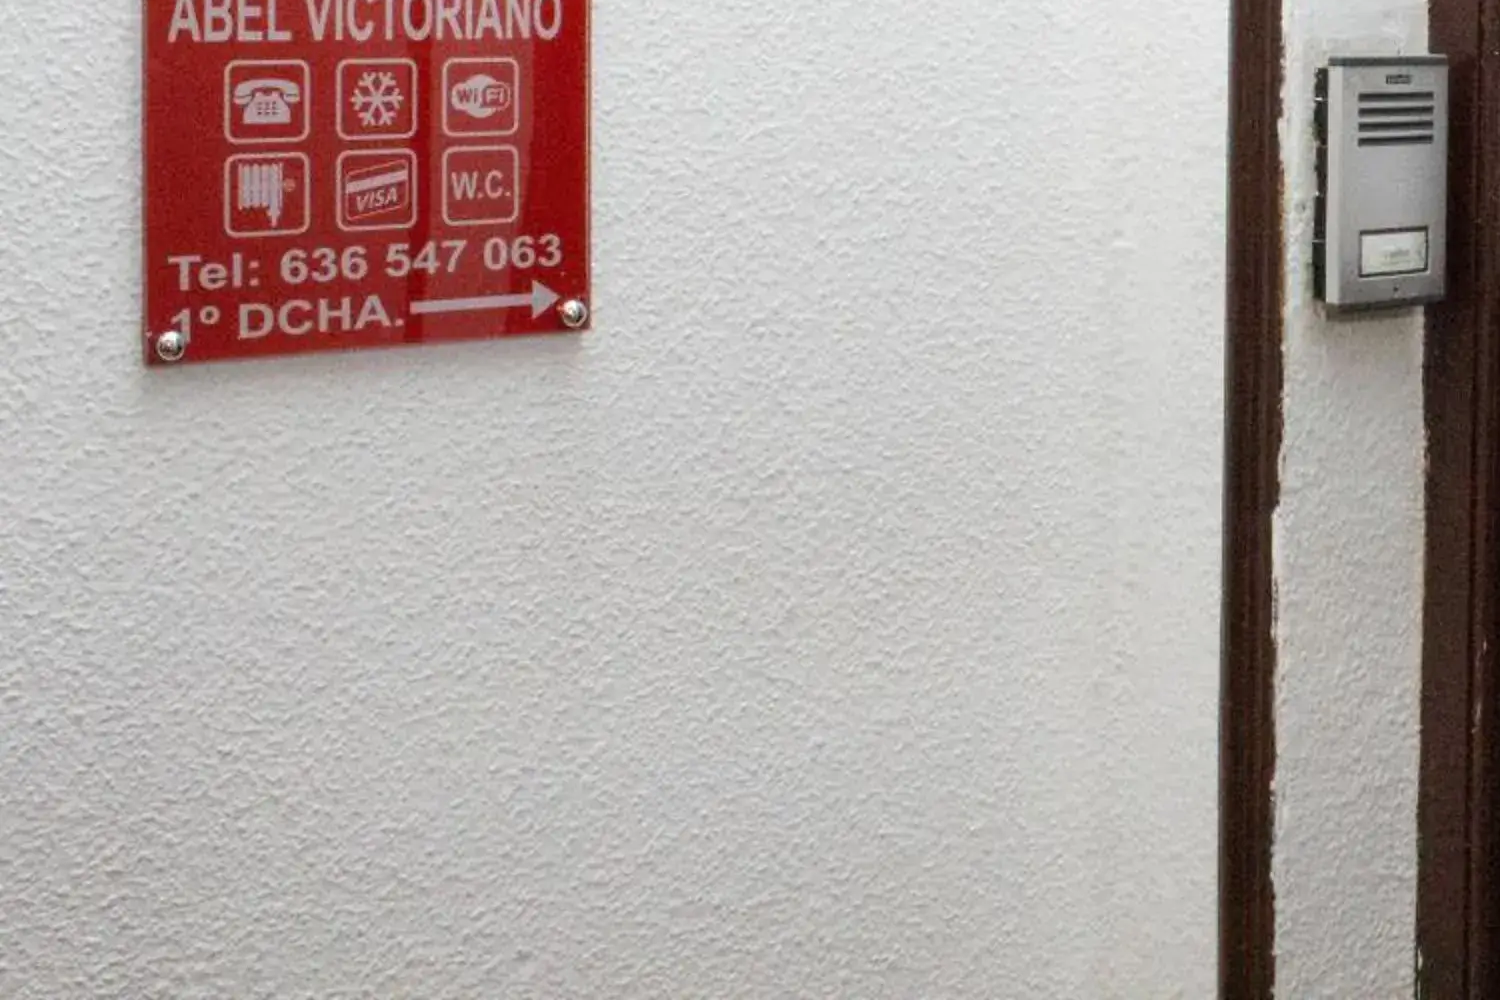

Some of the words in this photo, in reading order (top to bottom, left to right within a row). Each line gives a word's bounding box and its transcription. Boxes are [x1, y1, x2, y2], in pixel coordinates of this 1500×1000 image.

[356, 186, 398, 213] VISA
[451, 169, 512, 201] W.C.
[168, 251, 260, 292] Tel:
[279, 245, 369, 285] 636
[384, 241, 465, 278] 547
[483, 233, 563, 270] 063
[237, 294, 405, 341] DCHA.
